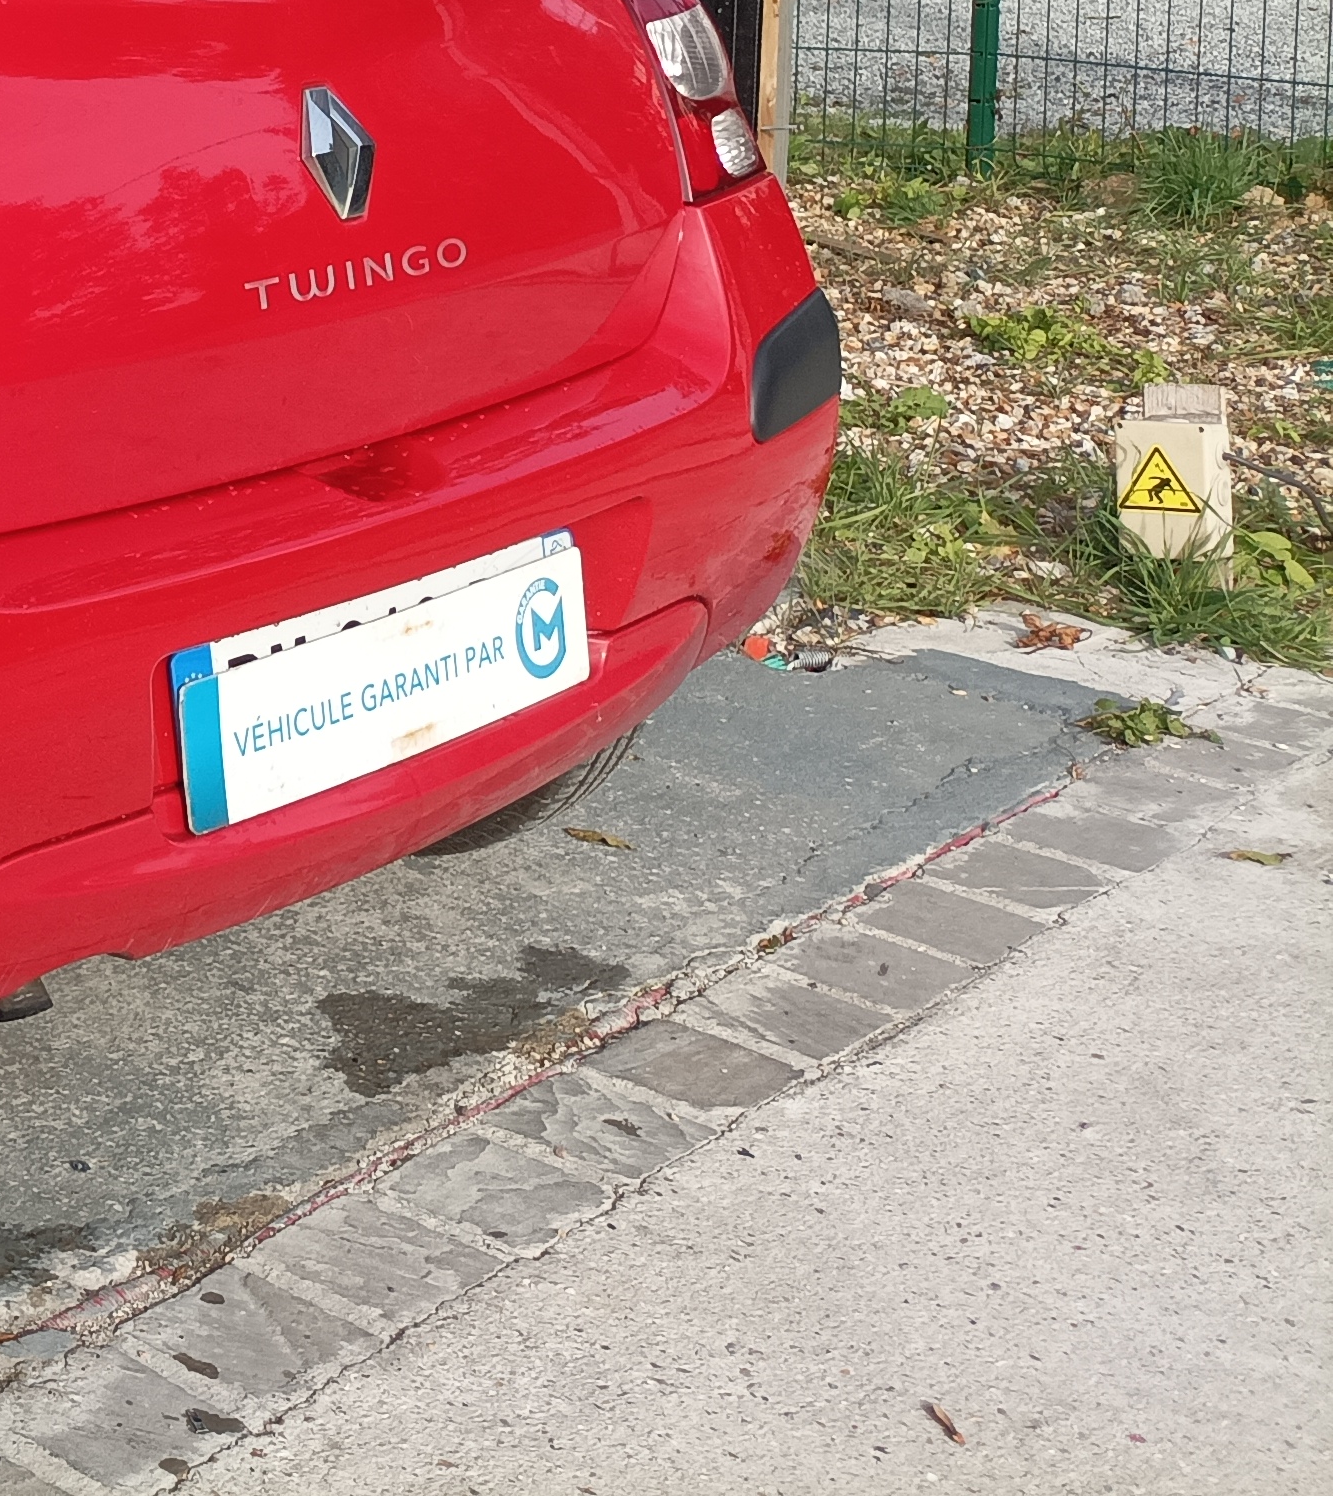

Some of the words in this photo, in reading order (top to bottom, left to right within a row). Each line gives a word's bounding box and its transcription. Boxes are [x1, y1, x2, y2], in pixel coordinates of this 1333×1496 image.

[244, 237, 468, 311] TWINGO
[233, 691, 354, 757] VÉHICULE
[360, 652, 459, 713] GARANTI
[464, 635, 505, 674] PAR
